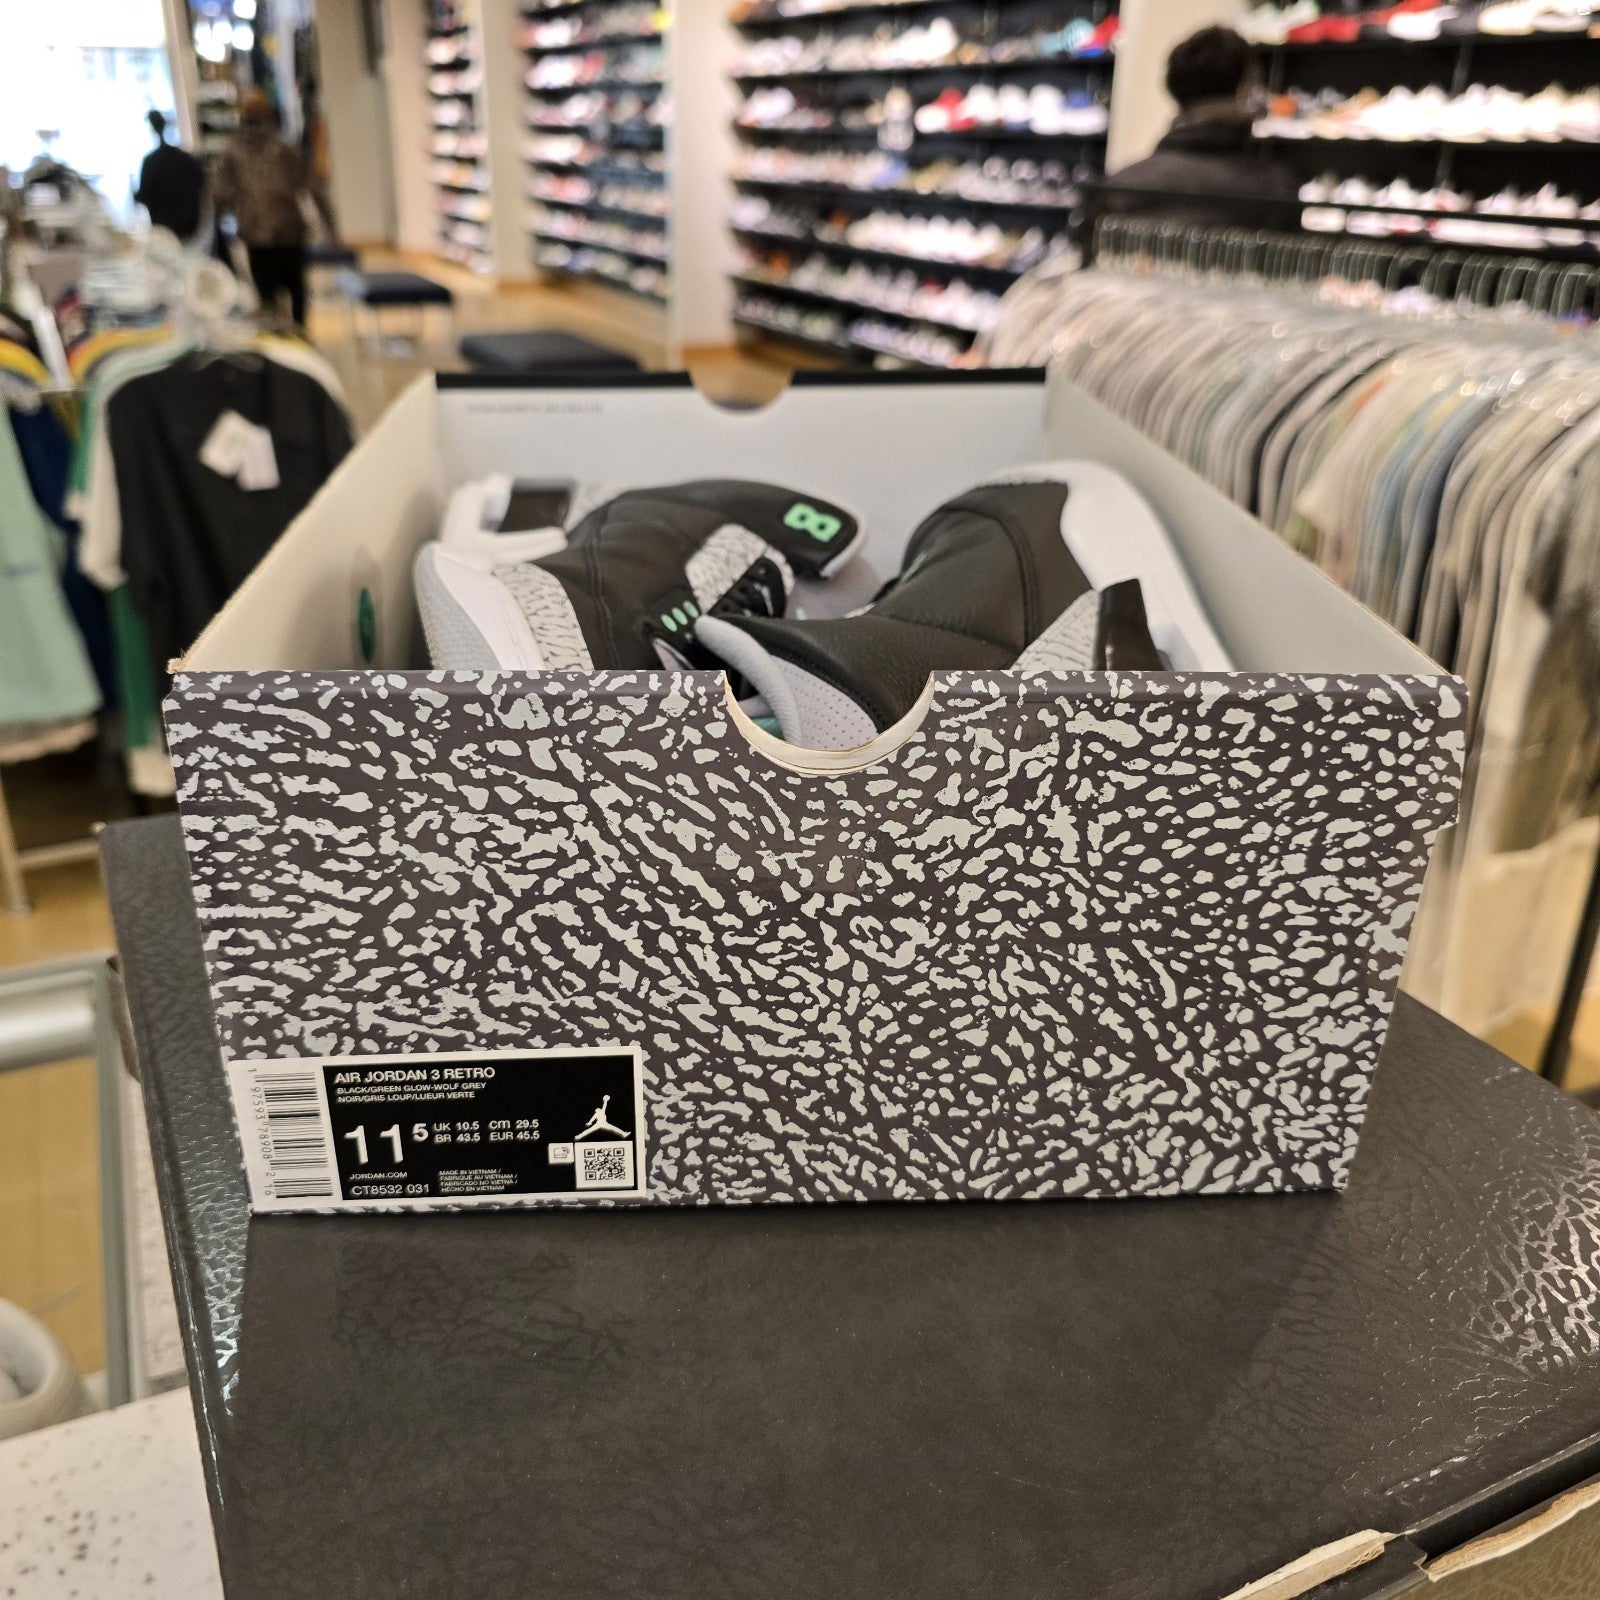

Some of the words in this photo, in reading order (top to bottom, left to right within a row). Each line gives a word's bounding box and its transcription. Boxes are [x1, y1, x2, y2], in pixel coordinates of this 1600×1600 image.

[335, 1072, 361, 1084] AIR
[365, 1070, 428, 1082] JORDAN
[431, 1069, 440, 1080] 3
[444, 1067, 495, 1079] RETRO
[337, 1086, 401, 1094] BLACK/GREEN
[404, 1084, 459, 1092] GLOW-WOLF
[338, 1095, 385, 1103] NOIR/GRIS
[388, 1092, 445, 1101] LOUP/LUEUR
[251, 1087, 265, 1120] 97593
[258, 1127, 273, 1160] 78908
[434, 1122, 450, 1132] UK
[456, 1122, 479, 1130] 10.5
[489, 1120, 510, 1129] cm
[516, 1119, 539, 1129] 29.5
[435, 1134, 451, 1143] BR
[456, 1133, 480, 1142] 43.5
[490, 1133, 513, 1141] EUR
[517, 1131, 540, 1140] 45.5
[344, 1124, 403, 1165] 11
[412, 1123, 428, 1142] 5
[350, 1172, 407, 1180] JORDAN.COM
[351, 1185, 403, 1195] CT8532
[406, 1184, 429, 1194] 031
